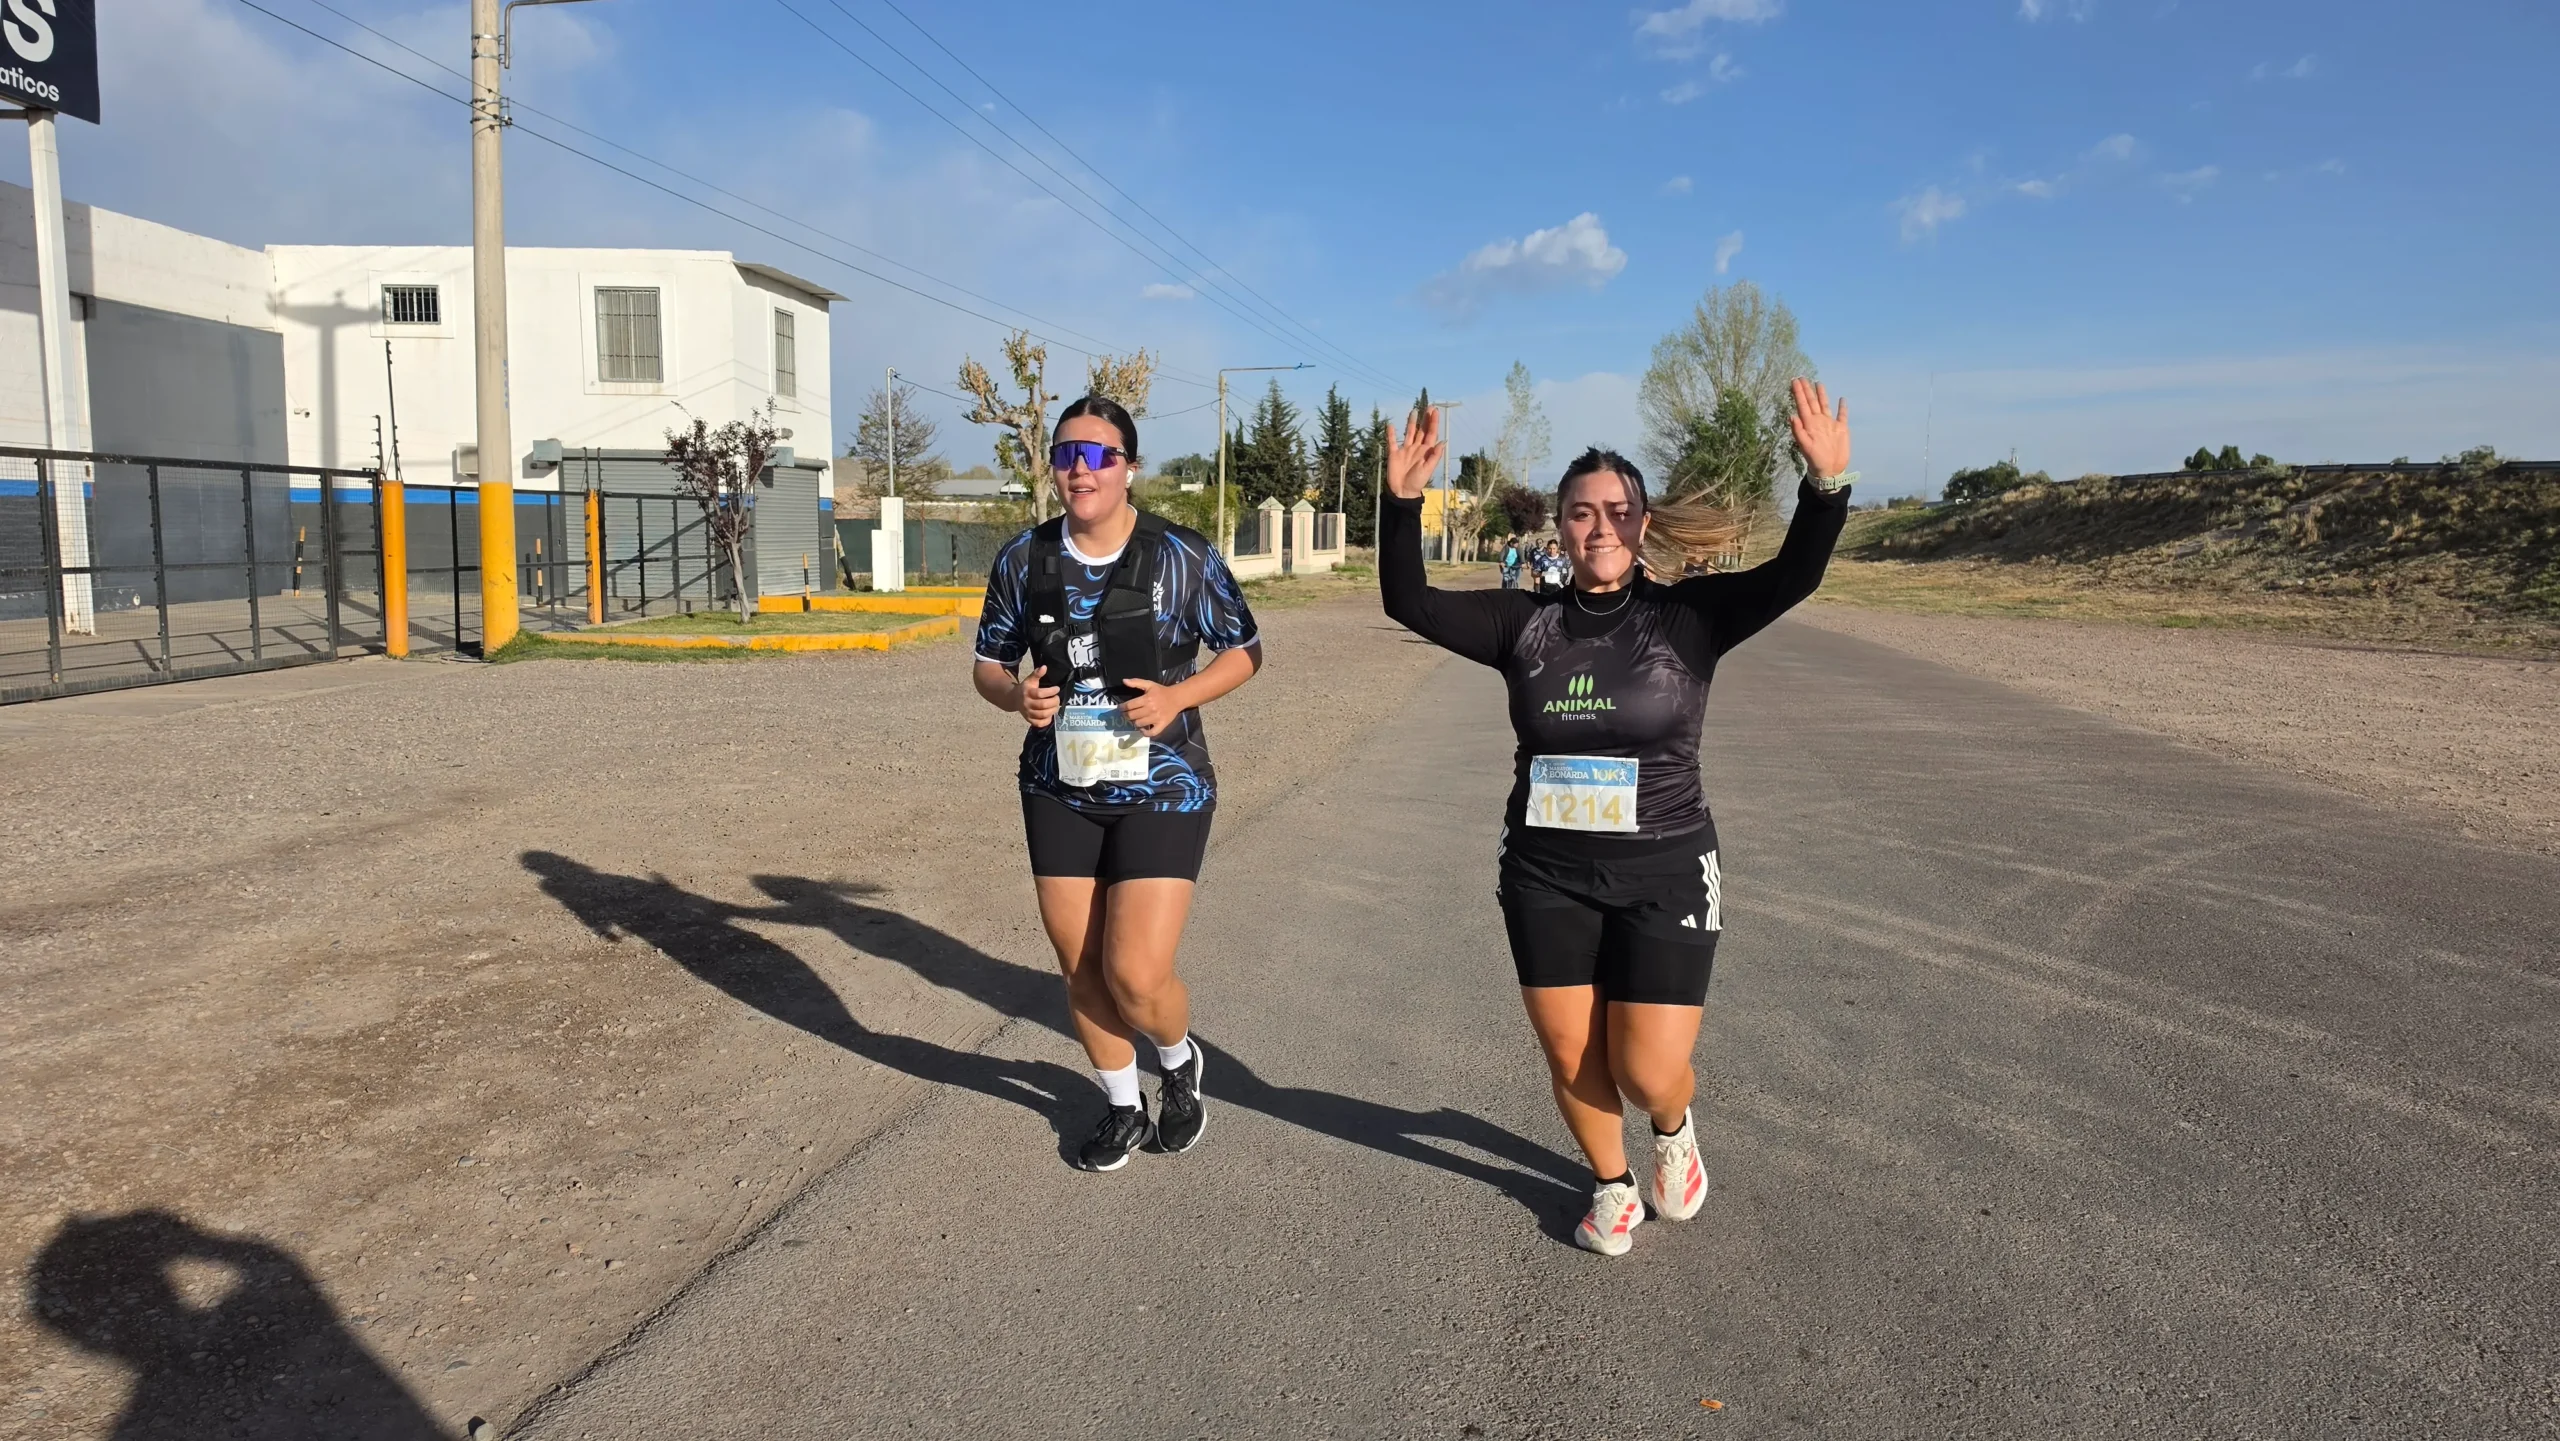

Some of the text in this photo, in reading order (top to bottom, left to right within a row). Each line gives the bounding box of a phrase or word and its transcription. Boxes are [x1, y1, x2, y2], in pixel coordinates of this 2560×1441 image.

[0, 0, 57, 63] S
[1087, 692, 1117, 706] MA
[1543, 697, 1616, 713] ANIMAL
[1069, 719, 1107, 727] BONARDA
[1561, 712, 1597, 721] fitness
[1066, 739, 1138, 766] 1215
[1549, 767, 1619, 782] BONARDA 10K
[1541, 793, 1623, 825] 1214
